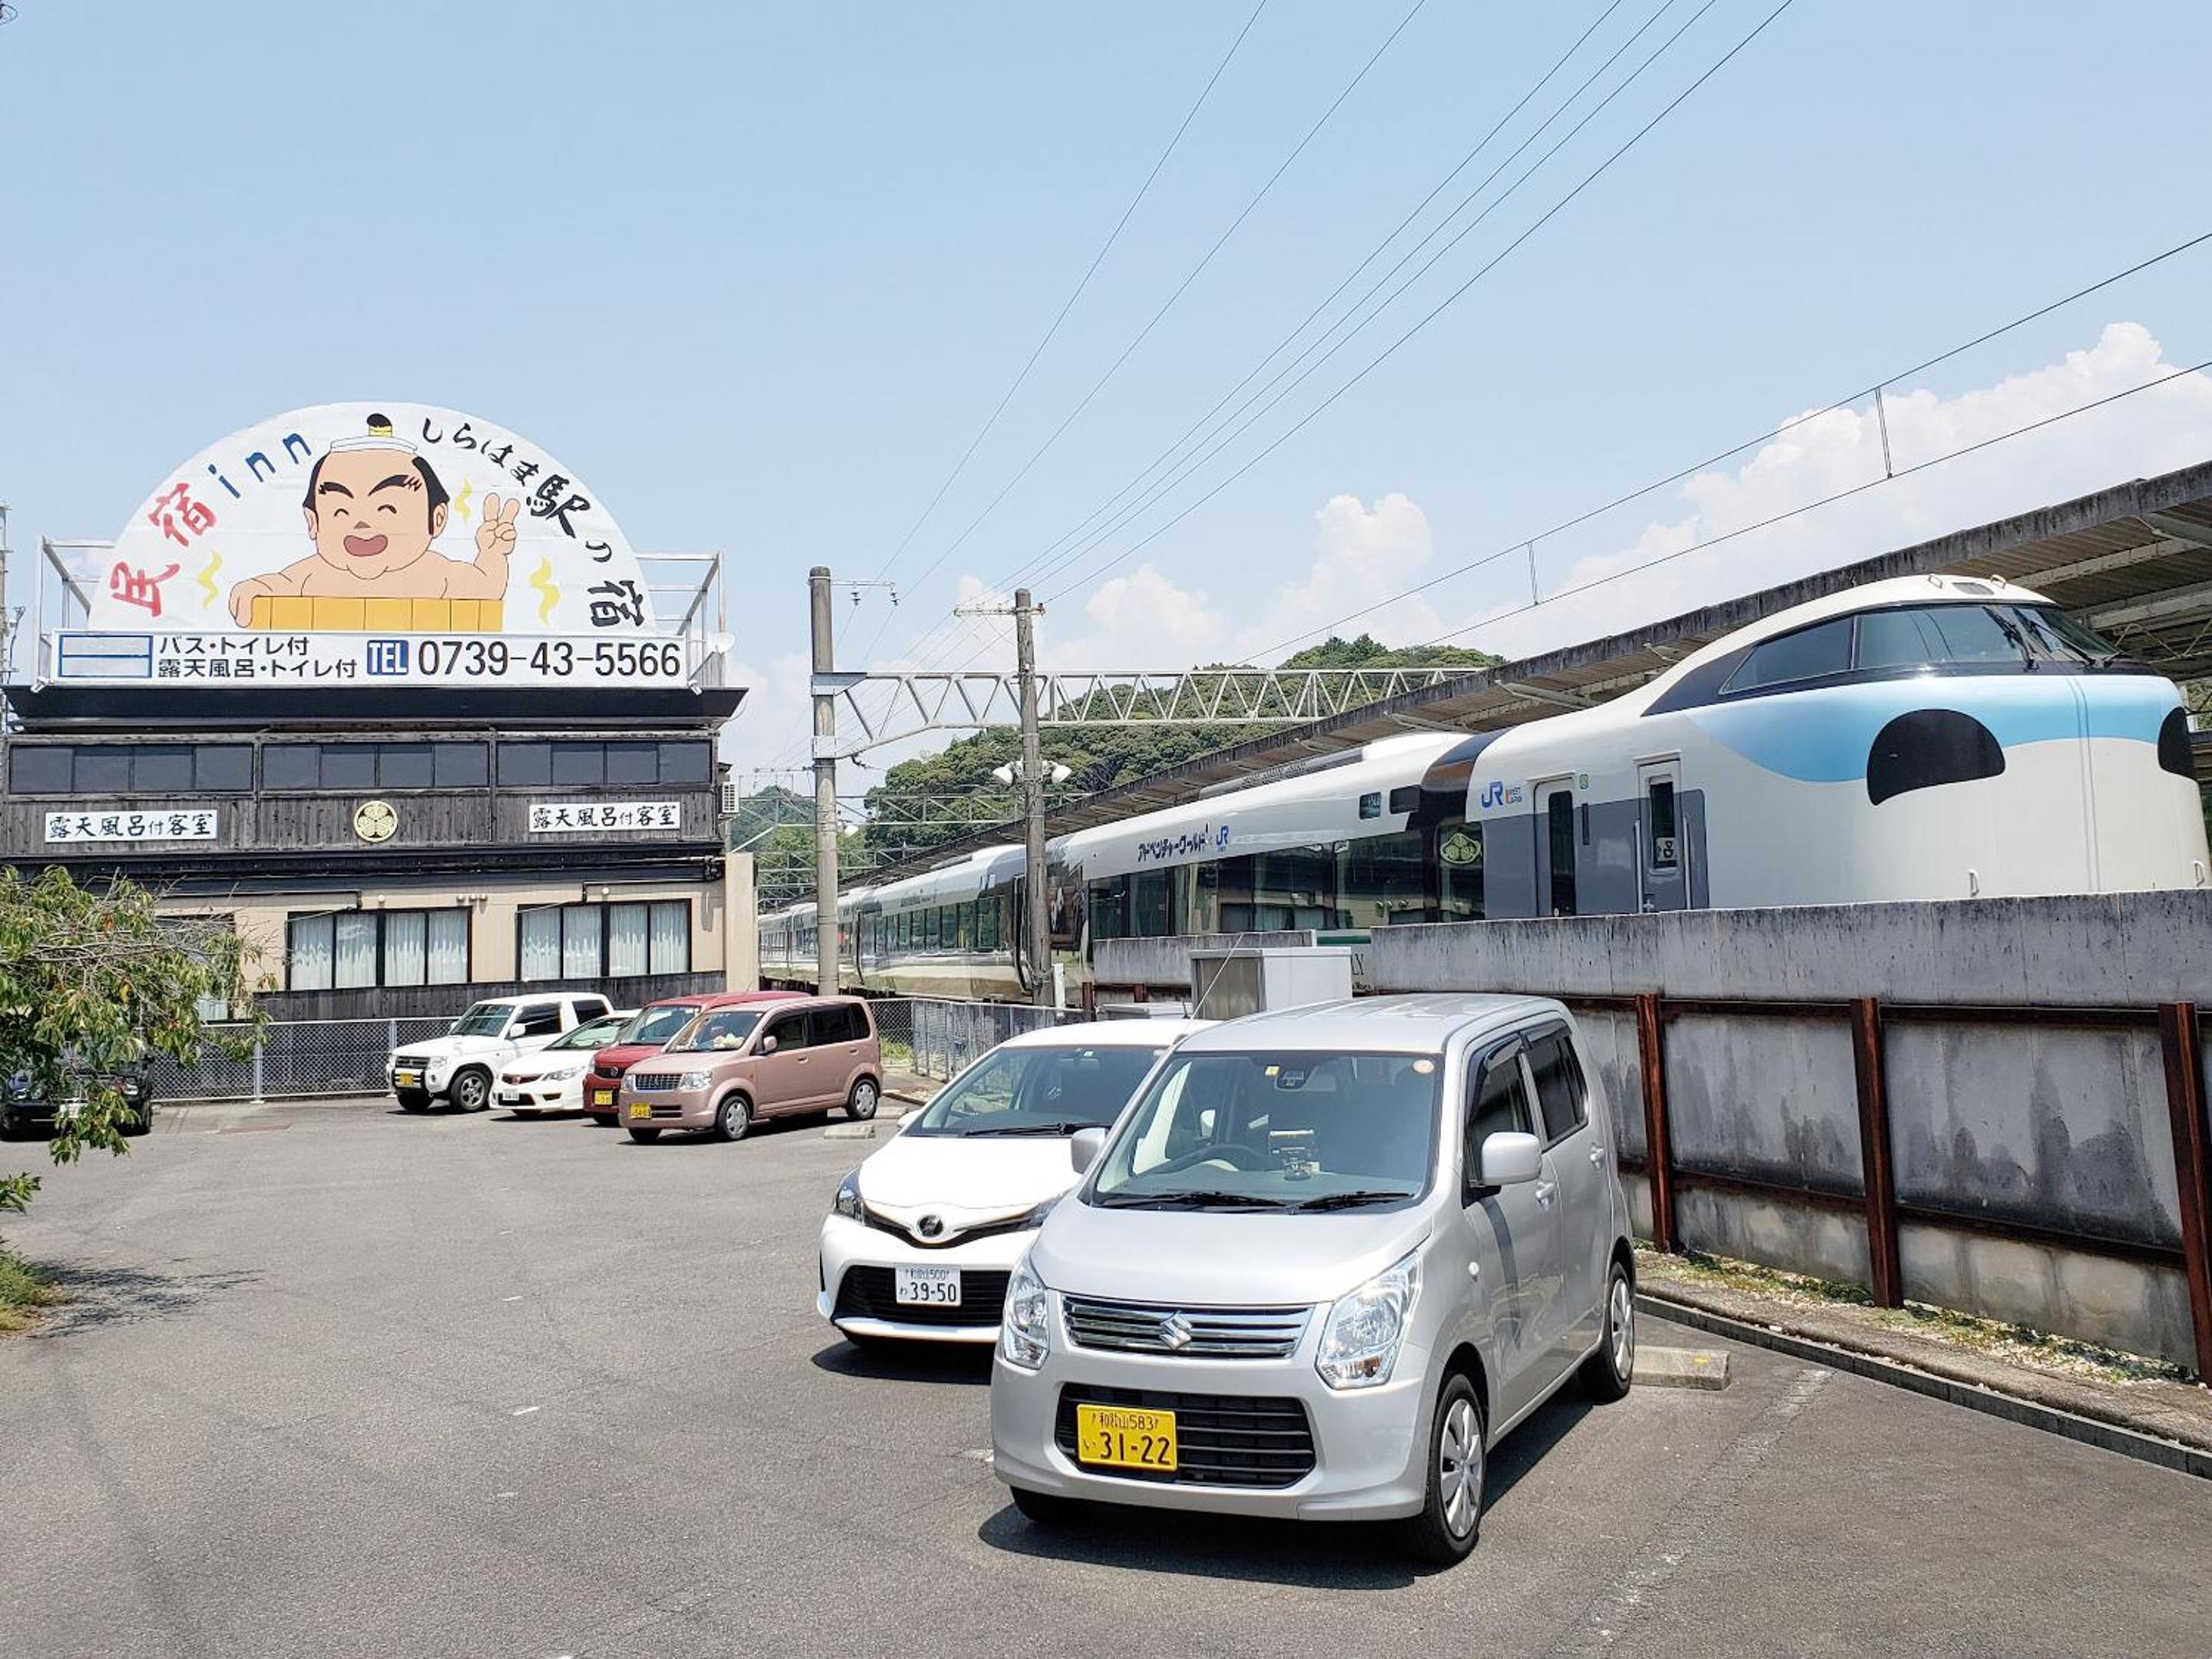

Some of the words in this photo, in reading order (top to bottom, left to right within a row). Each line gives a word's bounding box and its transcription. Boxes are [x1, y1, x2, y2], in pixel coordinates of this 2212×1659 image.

[110, 482, 217, 618] 民宿
[207, 432, 312, 499] inn
[422, 418, 645, 627] しらはま駅の宿
[160, 637, 310, 656] バス・トイレ付
[368, 642, 409, 674] TEL
[419, 640, 681, 677] 0739-43-5566
[158, 659, 357, 678] 露天風呂・トイレ付
[1482, 781, 1503, 808] JR
[49, 813, 214, 839] 露天風呂付客室
[533, 804, 676, 830] 露天風呂付客室
[1216, 825, 1229, 846] JR
[909, 1281, 957, 1303] 39-50
[1099, 1431, 1171, 1465] 31-22
